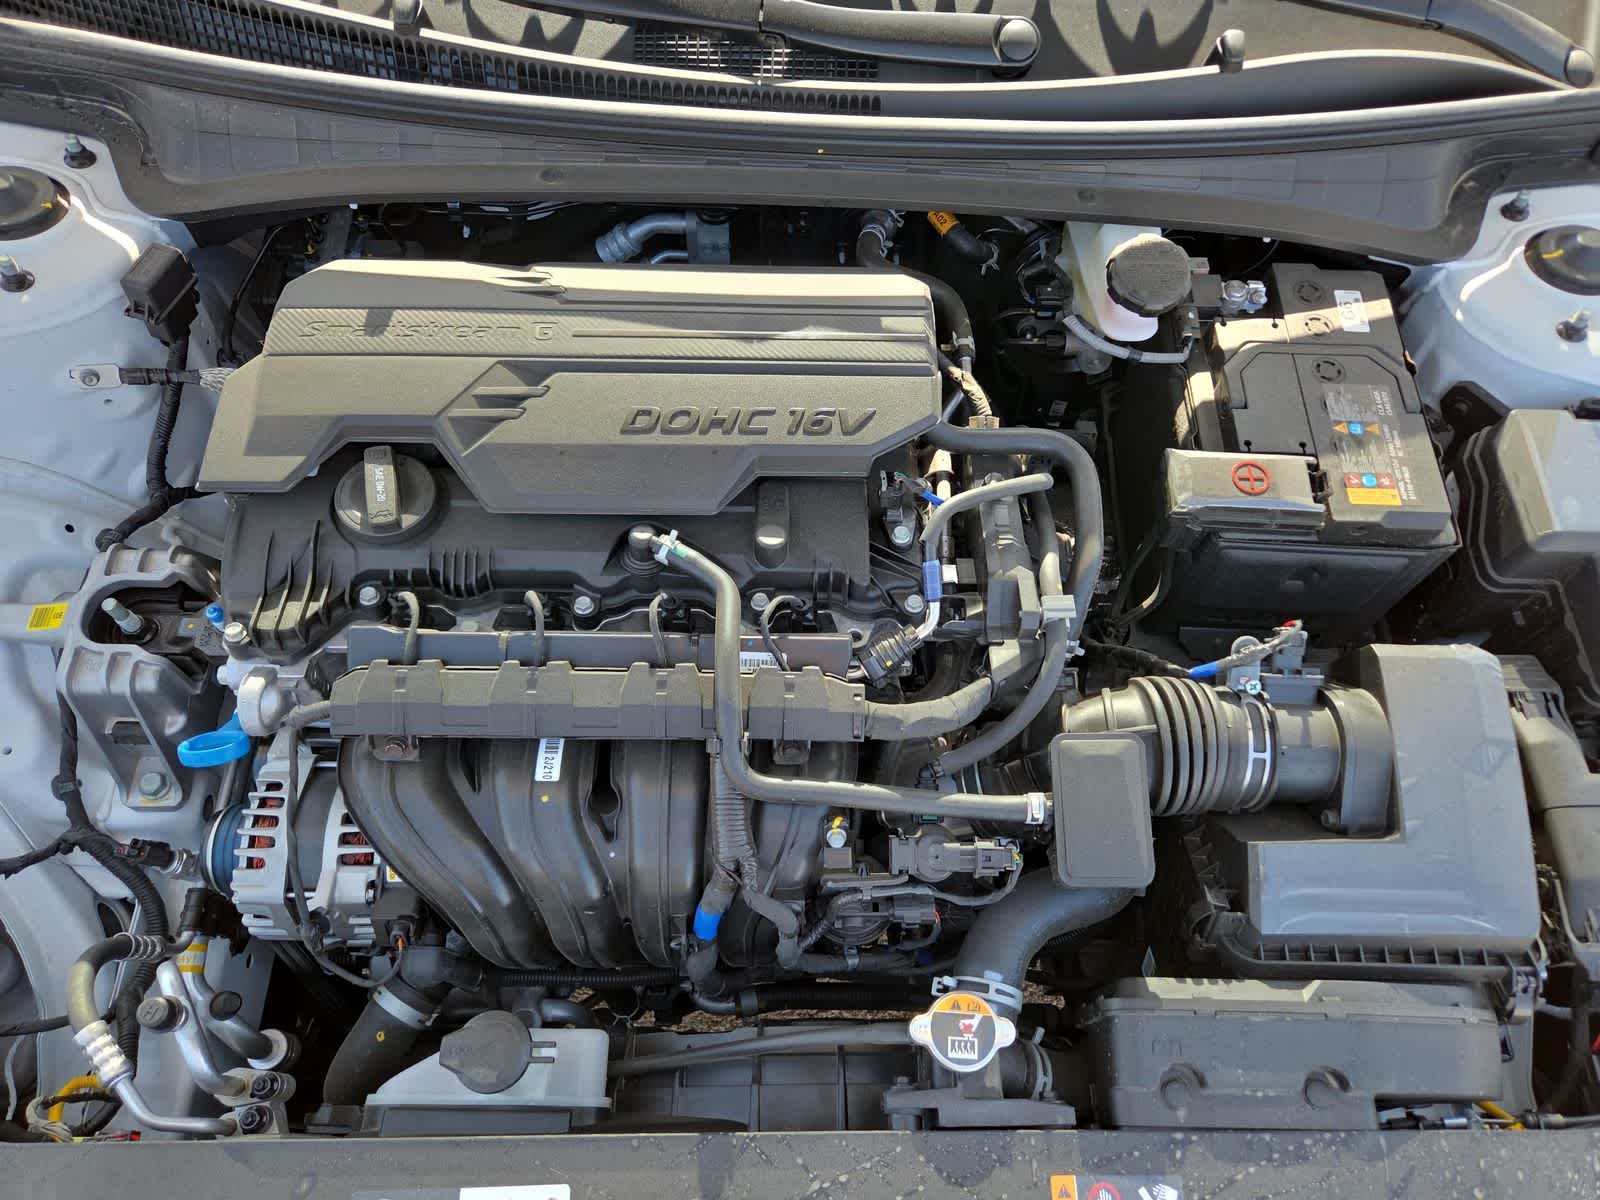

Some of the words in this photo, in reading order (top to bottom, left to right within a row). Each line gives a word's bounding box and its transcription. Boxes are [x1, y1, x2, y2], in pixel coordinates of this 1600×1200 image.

[620, 405, 777, 436] DOHC
[786, 406, 878, 437] 16V
[542, 756, 555, 780] 2J210
